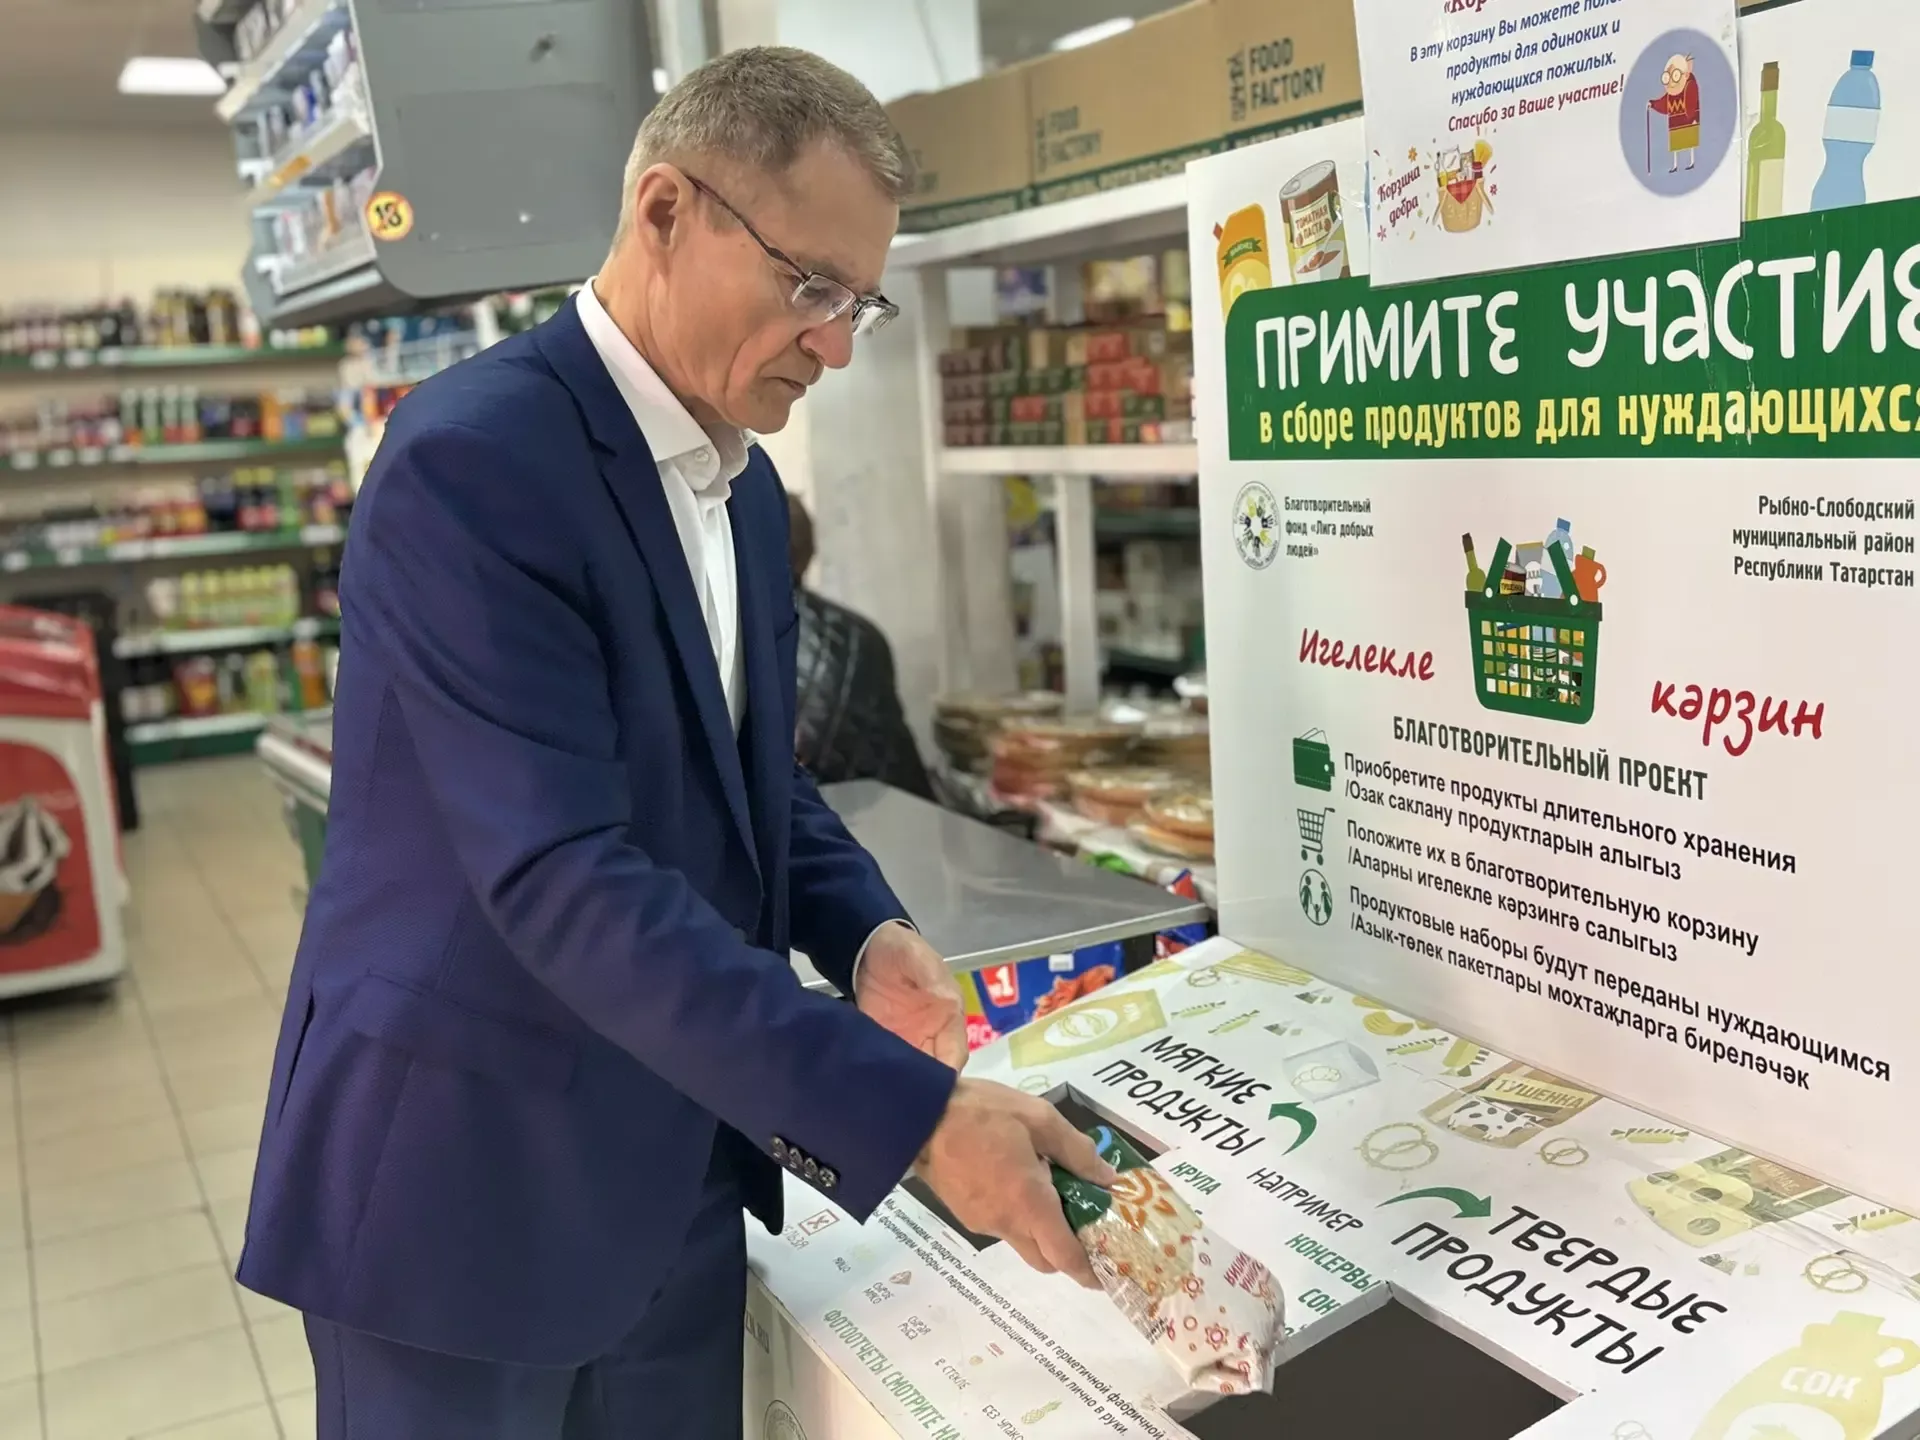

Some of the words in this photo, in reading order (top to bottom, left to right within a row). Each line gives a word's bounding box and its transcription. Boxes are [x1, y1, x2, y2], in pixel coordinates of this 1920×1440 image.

[1249, 37, 1293, 76] FOOD
[1410, 47, 1417, 62] В
[1420, 41, 1444, 59] эту
[1446, 26, 1495, 52] корзину
[1499, 19, 1517, 37] Вы
[1520, 1, 1579, 31] можете
[1446, 50, 1511, 79] продукты
[1514, 43, 1538, 61] для
[1541, 26, 1608, 53] одиноких
[1612, 19, 1620, 33] и
[1251, 62, 1325, 111] FACTORY
[1448, 106, 1498, 132] Спасибо
[1500, 104, 1515, 120] за
[1518, 95, 1555, 116] Ваше
[1558, 74, 1625, 111] участие!
[1451, 70, 1543, 107] нуждающихся
[1546, 51, 1617, 81] пожилых.
[1377, 166, 1420, 202] Корзина
[1388, 195, 1419, 227] добра
[1255, 290, 1519, 390] ПРИМИТЕ
[1259, 413, 1273, 443] в
[1282, 402, 1353, 449] сборе
[1365, 398, 1521, 449] продуктов
[1536, 397, 1601, 446] для
[1618, 384, 1920, 446] нуждающихс
[1284, 496, 1371, 514] Благотворительный
[1286, 520, 1307, 536] фонд
[1311, 520, 1336, 536] «Лига
[1340, 522, 1374, 539] добрых
[1758, 495, 1914, 522] Рыбно-Слободский
[1286, 543, 1319, 558] людей»
[1733, 529, 1856, 551] муниципальный
[1864, 532, 1914, 555] район
[1734, 556, 1823, 581] Республики
[1830, 562, 1914, 588] Татарстан
[1299, 628, 1435, 682] Игелекле
[1651, 680, 1826, 757] кәрзин
[1393, 715, 1610, 782] БЛАГОТВОРИТЕЛЬНЫЙ
[1618, 757, 1708, 801] ПРОЕКТ
[1345, 752, 1445, 792] Приобретите
[1451, 779, 1537, 813] продукты
[1543, 800, 1676, 845] длительного
[1684, 831, 1796, 874] хранения
[1345, 779, 1384, 806] /Озак
[1388, 793, 1452, 827] саклану
[1458, 810, 1593, 858] продуктларын
[1600, 844, 1681, 880] алыгыз
[1347, 819, 1422, 856] Положите
[1427, 845, 1446, 864] их
[1451, 851, 1461, 867] в
[1466, 852, 1660, 923] благотворительную
[1667, 911, 1759, 957] корзину
[1348, 846, 1413, 882] /Аларны
[1418, 870, 1493, 906] игелекле
[1498, 893, 1579, 932] кәрзингә
[1586, 920, 1678, 962] салыгыз
[1350, 885, 1455, 936] Продуктовые
[1460, 924, 1528, 961] наборы
[1534, 945, 1588, 982] будут
[1594, 968, 1699, 1018] переданы
[1707, 1005, 1891, 1082] нуждающимся
[1350, 912, 1443, 961] /Азык-төлек
[1448, 949, 1542, 996] пакетлары
[1685, 1027, 1810, 1090] биреләчәк
[1141, 1035, 1272, 1105] МЯГКИЕ
[1495, 1079, 1584, 1109] ТУШЕНКА
[1092, 1058, 1266, 1157] ПРОДУКТЫ
[1169, 1161, 1222, 1196] КРУПА
[879, 1216, 917, 1249] формируем
[914, 1247, 944, 1273] наборы
[1284, 1233, 1381, 1292] КОНСЕРВЫ
[1488, 1205, 1727, 1335] ТВЕРДЫЕ
[945, 1274, 983, 1306] передаем
[1297, 1287, 1341, 1316] СОК
[1391, 1222, 1664, 1375] ПРОДУКТЫ
[930, 1240, 966, 1274] продукты
[960, 1268, 1011, 1310] длительного
[1009, 1307, 1048, 1341] хранения
[1045, 1340, 1055, 1348] в
[1052, 1345, 1112, 1395] герметичной
[1107, 1392, 1167, 1440] фабричной
[980, 1304, 1037, 1355] нуждающимся
[823, 1309, 893, 1375] ФОТООТЧЕТЫ
[881, 1371, 945, 1429] СМОТРИТЕ
[1034, 1352, 1069, 1384] семьям
[1780, 1366, 1862, 1400] СОК
[1065, 1381, 1097, 1407] лично
[1094, 1405, 1105, 1415] в
[1098, 1413, 1128, 1437] руки.
